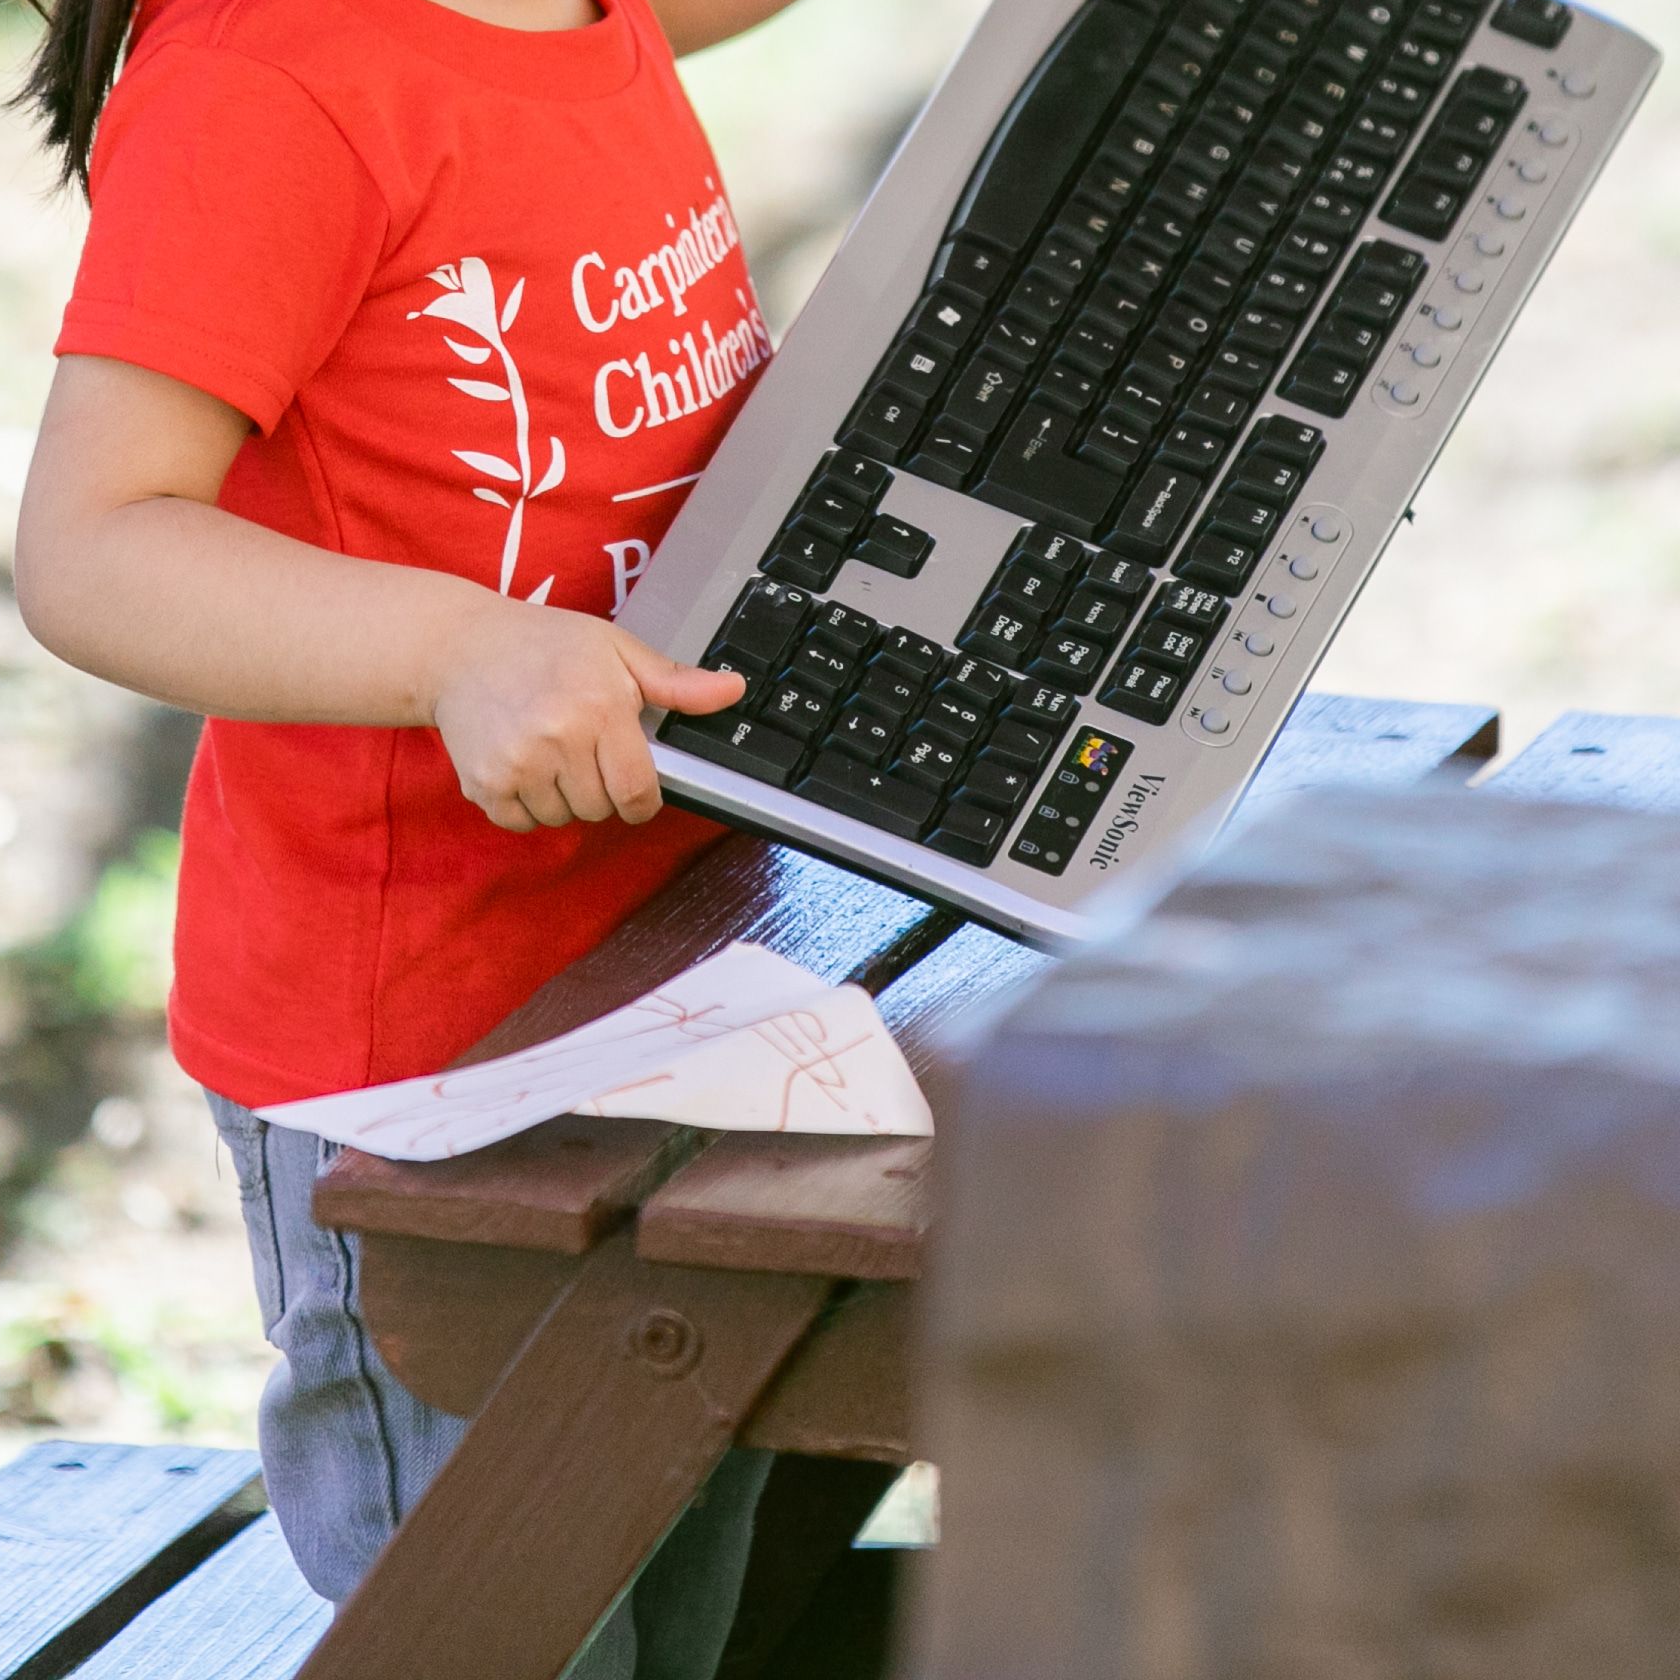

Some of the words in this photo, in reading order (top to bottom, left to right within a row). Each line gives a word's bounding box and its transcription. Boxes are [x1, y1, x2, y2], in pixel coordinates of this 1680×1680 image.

[1283, 163, 1301, 178] T
[1110, 178, 1130, 194] N
[1188, 183, 1207, 199] H
[1260, 202, 1278, 215] Y
[1164, 222, 1181, 237] J
[1235, 238, 1254, 254] U
[1293, 235, 1308, 247] 7
[1142, 261, 1162, 276] K
[1118, 300, 1138, 309] L
[1189, 318, 1208, 332] O
[1021, 336, 1036, 346] ?
[594, 288, 770, 437] Children's
[1169, 354, 1185, 369] P
[976, 383, 994, 402] Shift
[884, 406, 900, 422] Ctrl
[1300, 428, 1314, 442] F9
[1023, 439, 1042, 460] Enter
[1274, 469, 1291, 485] F10
[1252, 509, 1268, 524] F11
[1044, 537, 1065, 559] Delete
[1227, 548, 1244, 565] F12
[1109, 561, 1130, 583] Insert
[765, 582, 781, 596] Ins
[1023, 577, 1041, 596] End
[788, 592, 802, 602] 0
[1187, 591, 1208, 614] Screen
[1201, 594, 1219, 612] Print
[829, 608, 846, 625] End
[1085, 602, 1105, 623] Home
[990, 615, 1010, 636] Down
[1004, 621, 1023, 641] Page
[1058, 641, 1075, 653] Up
[1162, 631, 1182, 650] Lock
[1174, 636, 1194, 657] Scroll
[920, 645, 932, 655] 4
[1070, 645, 1089, 665] Page
[829, 659, 844, 670] 2
[957, 660, 977, 682] Home
[987, 671, 1001, 682] 7
[1125, 666, 1145, 688] Break
[895, 685, 909, 696] 5
[1150, 675, 1171, 698] Pause
[779, 690, 799, 712] PgDn
[805, 700, 820, 711] 3
[1032, 688, 1051, 707] Lock
[1048, 693, 1066, 711] Num
[961, 711, 976, 722] 8
[732, 723, 751, 745] Enter
[871, 727, 886, 737] 6
[910, 743, 932, 763] PgUp
[938, 752, 952, 763] 9
[870, 777, 881, 786] +
[1090, 773, 1166, 870] ViewSonic
